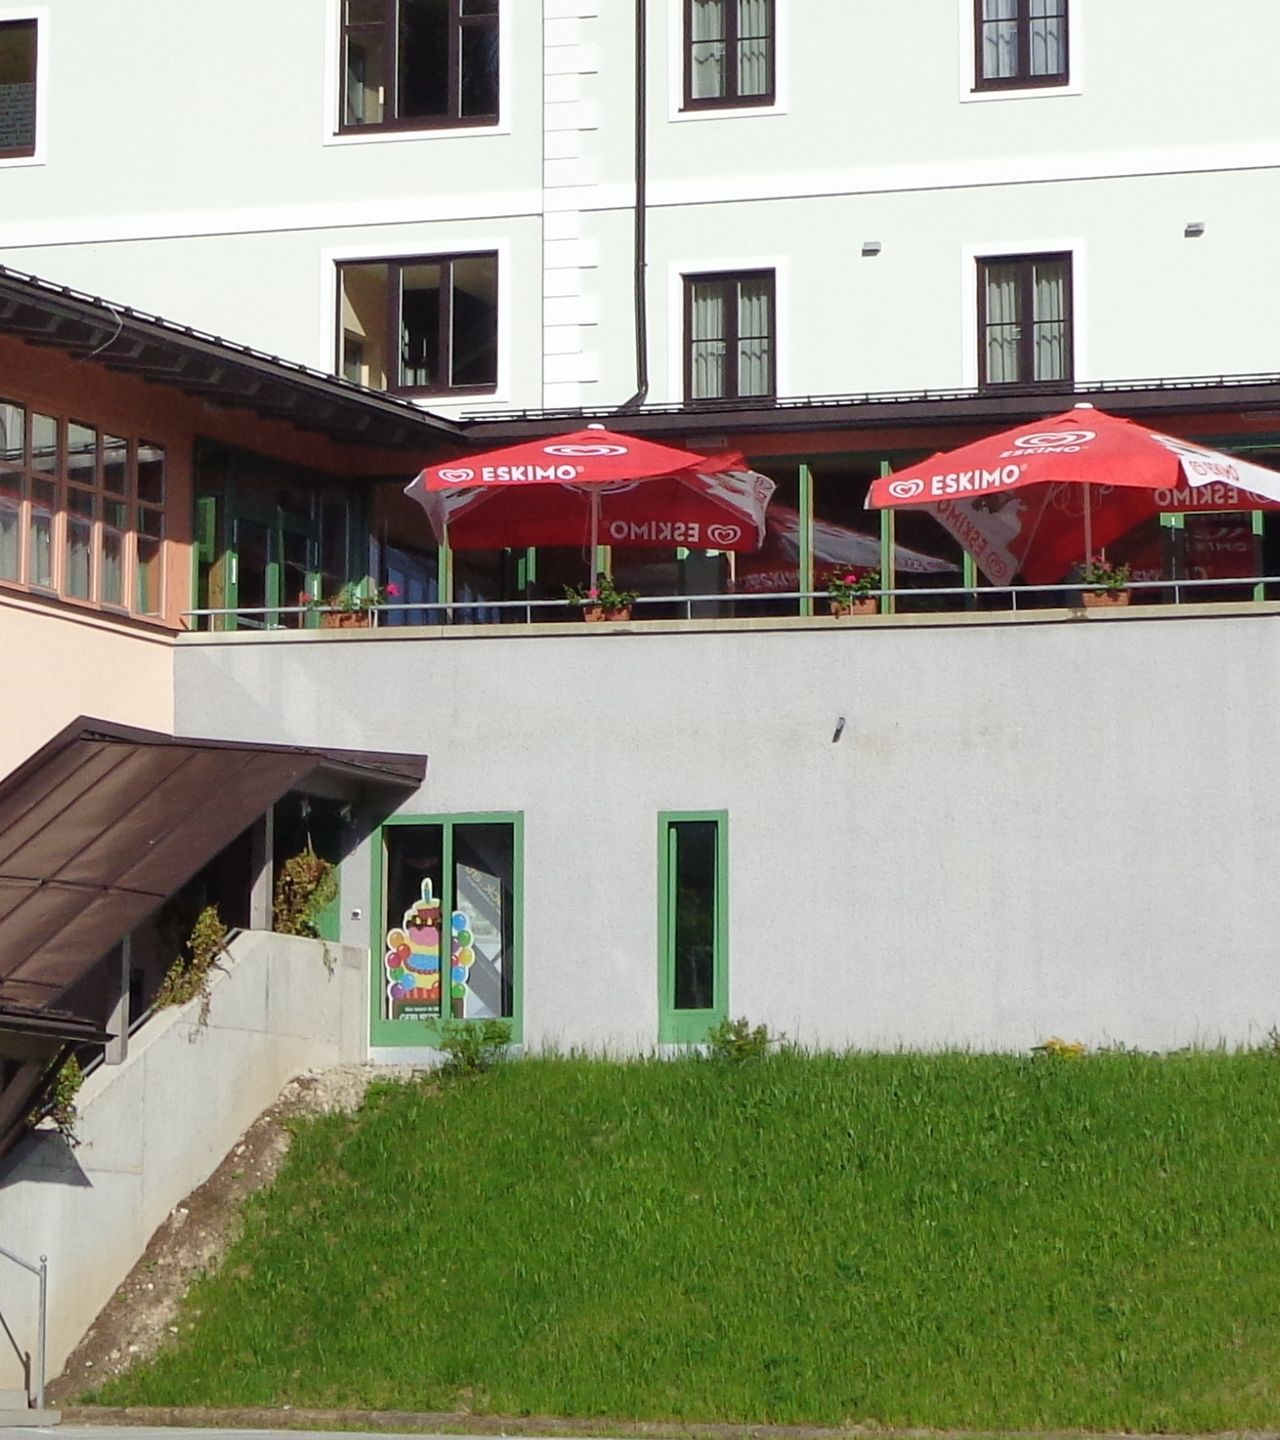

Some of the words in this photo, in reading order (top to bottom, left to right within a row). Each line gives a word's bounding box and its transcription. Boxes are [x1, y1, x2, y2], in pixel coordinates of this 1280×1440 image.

[1000, 445, 1082, 459] ESKIMO
[481, 464, 577, 482] ESKIMO
[931, 464, 1021, 496] ESKIMO
